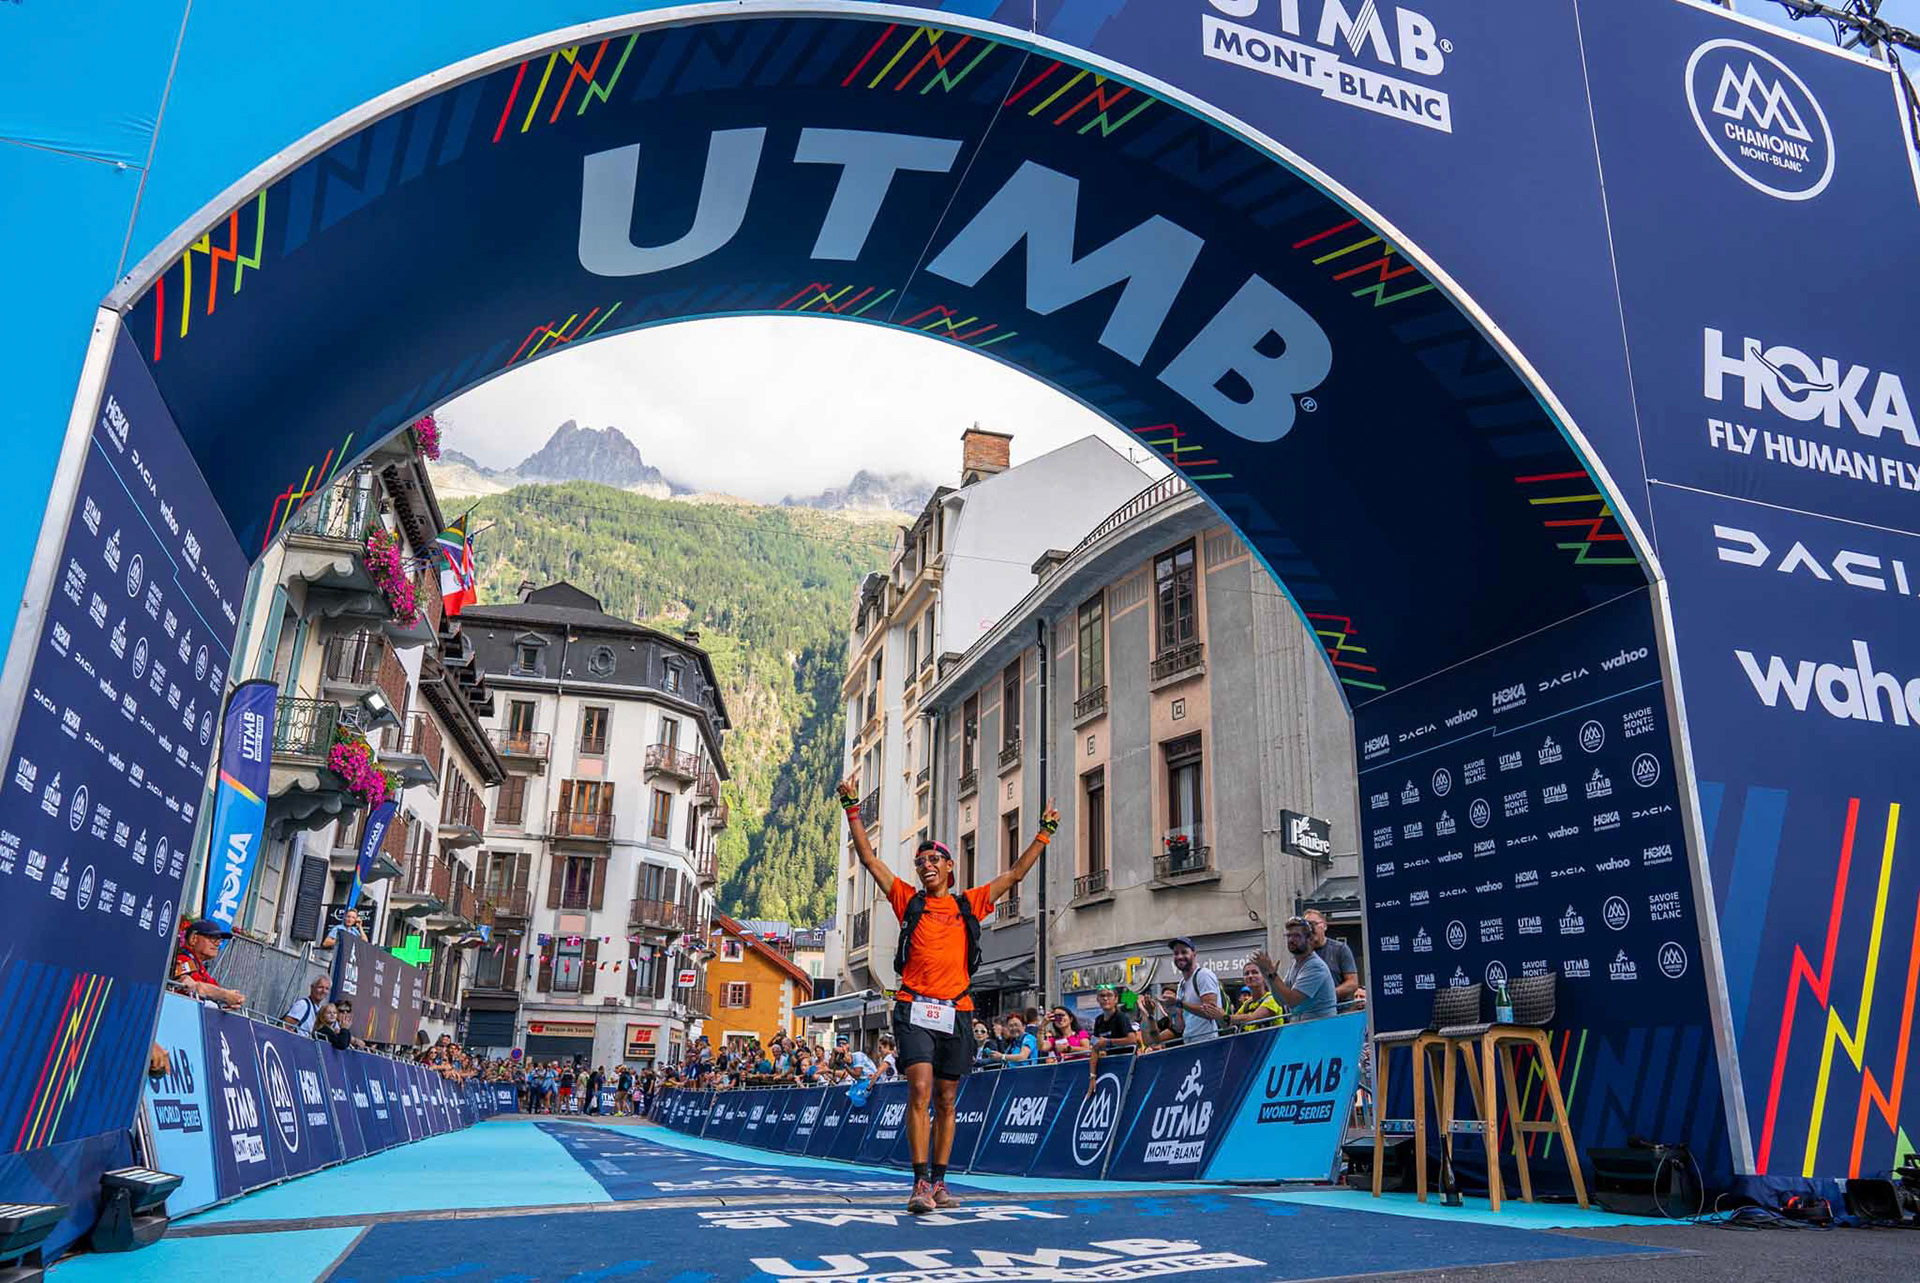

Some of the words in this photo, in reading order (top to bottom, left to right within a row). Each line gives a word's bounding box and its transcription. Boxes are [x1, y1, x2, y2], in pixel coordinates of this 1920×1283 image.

[1208, 0, 1446, 76] MB
[1213, 27, 1442, 122] MONT-BLANC
[1724, 121, 1811, 162] CHAMONIX
[1739, 144, 1803, 174] MONT-BLANC
[577, 126, 1333, 443] UTMB
[1704, 327, 1920, 448] HOKA
[1708, 418, 1758, 455] FLY
[1763, 431, 1878, 483] HUMAN
[106, 394, 129, 443] HOKA
[131, 449, 156, 496] DACIA
[160, 499, 179, 536] wahoo
[1713, 523, 1920, 598] DACI
[53, 621, 71, 650] HOKA
[75, 652, 96, 678] DACIA
[1364, 734, 1390, 754] HOKA
[1399, 723, 1437, 742] DACIA
[1445, 708, 1478, 728] wahoo
[1492, 683, 1526, 706] HOKA
[1538, 667, 1589, 692] DACIA
[1601, 647, 1648, 671] wahoo
[33, 688, 56, 715] DACIA
[63, 707, 81, 732] HOKA
[85, 731, 104, 754] DACIA
[1623, 706, 1653, 722] SAVOIE
[1624, 717, 1648, 731] MONT
[242, 711, 256, 759] UTMB
[1625, 724, 1655, 739] BLANC
[1463, 759, 1485, 771] SAVOIE
[1499, 751, 1521, 765] UTMB
[1538, 745, 1562, 759] UTMB
[18, 757, 37, 781] UTMB
[1465, 773, 1487, 786] BLANC
[1542, 783, 1567, 797] UTMB
[1585, 778, 1611, 792] UTMB
[1401, 787, 1420, 800] UTMB
[1503, 790, 1528, 803] SAVOIE
[1505, 805, 1529, 818] BLANC
[1436, 818, 1455, 830] UTMB
[1376, 862, 1395, 873] HOKA
[1403, 858, 1430, 869] DACIA
[1437, 850, 1463, 863] wahoo
[1473, 839, 1496, 853] HOKA
[1506, 834, 1538, 847] DACIA
[1547, 825, 1579, 840] wahoo
[1593, 811, 1620, 826] HOKA
[1631, 804, 1672, 819] DACIA
[28, 848, 47, 870] UTMB
[212, 832, 253, 925] HOKA
[1374, 899, 1401, 908] DACIA
[1410, 889, 1429, 901] HOKA
[1439, 887, 1468, 898] DACIA
[1475, 880, 1503, 893] wahoo
[1515, 870, 1539, 883] HOKA
[1550, 866, 1585, 878] DACIA
[1595, 857, 1630, 872] wahoo
[1643, 844, 1672, 860] HOKA
[1649, 891, 1679, 904] SAVOIE
[1650, 902, 1675, 912] MONT
[1480, 917, 1503, 928] SAVOIE
[1517, 916, 1541, 928] UTMB
[1559, 916, 1584, 928] UTMB
[1651, 910, 1682, 921] BLANC
[1412, 936, 1432, 947] UTMB
[1481, 932, 1504, 943] BLANC
[1202, 959, 1230, 971] chez
[1522, 960, 1547, 970] SAVOIE
[1563, 959, 1589, 971] UTMB
[1609, 961, 1636, 974] UTMB
[1415, 973, 1436, 984] UTMB
[1450, 976, 1470, 987] UTMB
[927, 1010, 940, 1019] 83
[150, 1047, 194, 1095] MB
[1266, 1057, 1343, 1098] UTMB
[298, 1070, 323, 1105] HOKA
[156, 1106, 180, 1124] WORLD
[182, 1110, 200, 1127] SERIES
[849, 1114, 869, 1124] DACIA
[880, 1103, 906, 1127] HOKA
[955, 1111, 983, 1123] DACIA
[1005, 1096, 1048, 1127] HOKA
[1151, 1101, 1212, 1140] UTMB
[1262, 1103, 1297, 1120] WORLD
[1300, 1103, 1332, 1121] SERIES
[1147, 1143, 1203, 1160] MONT-BLANC
[750, 1238, 1198, 1278] UTMB
